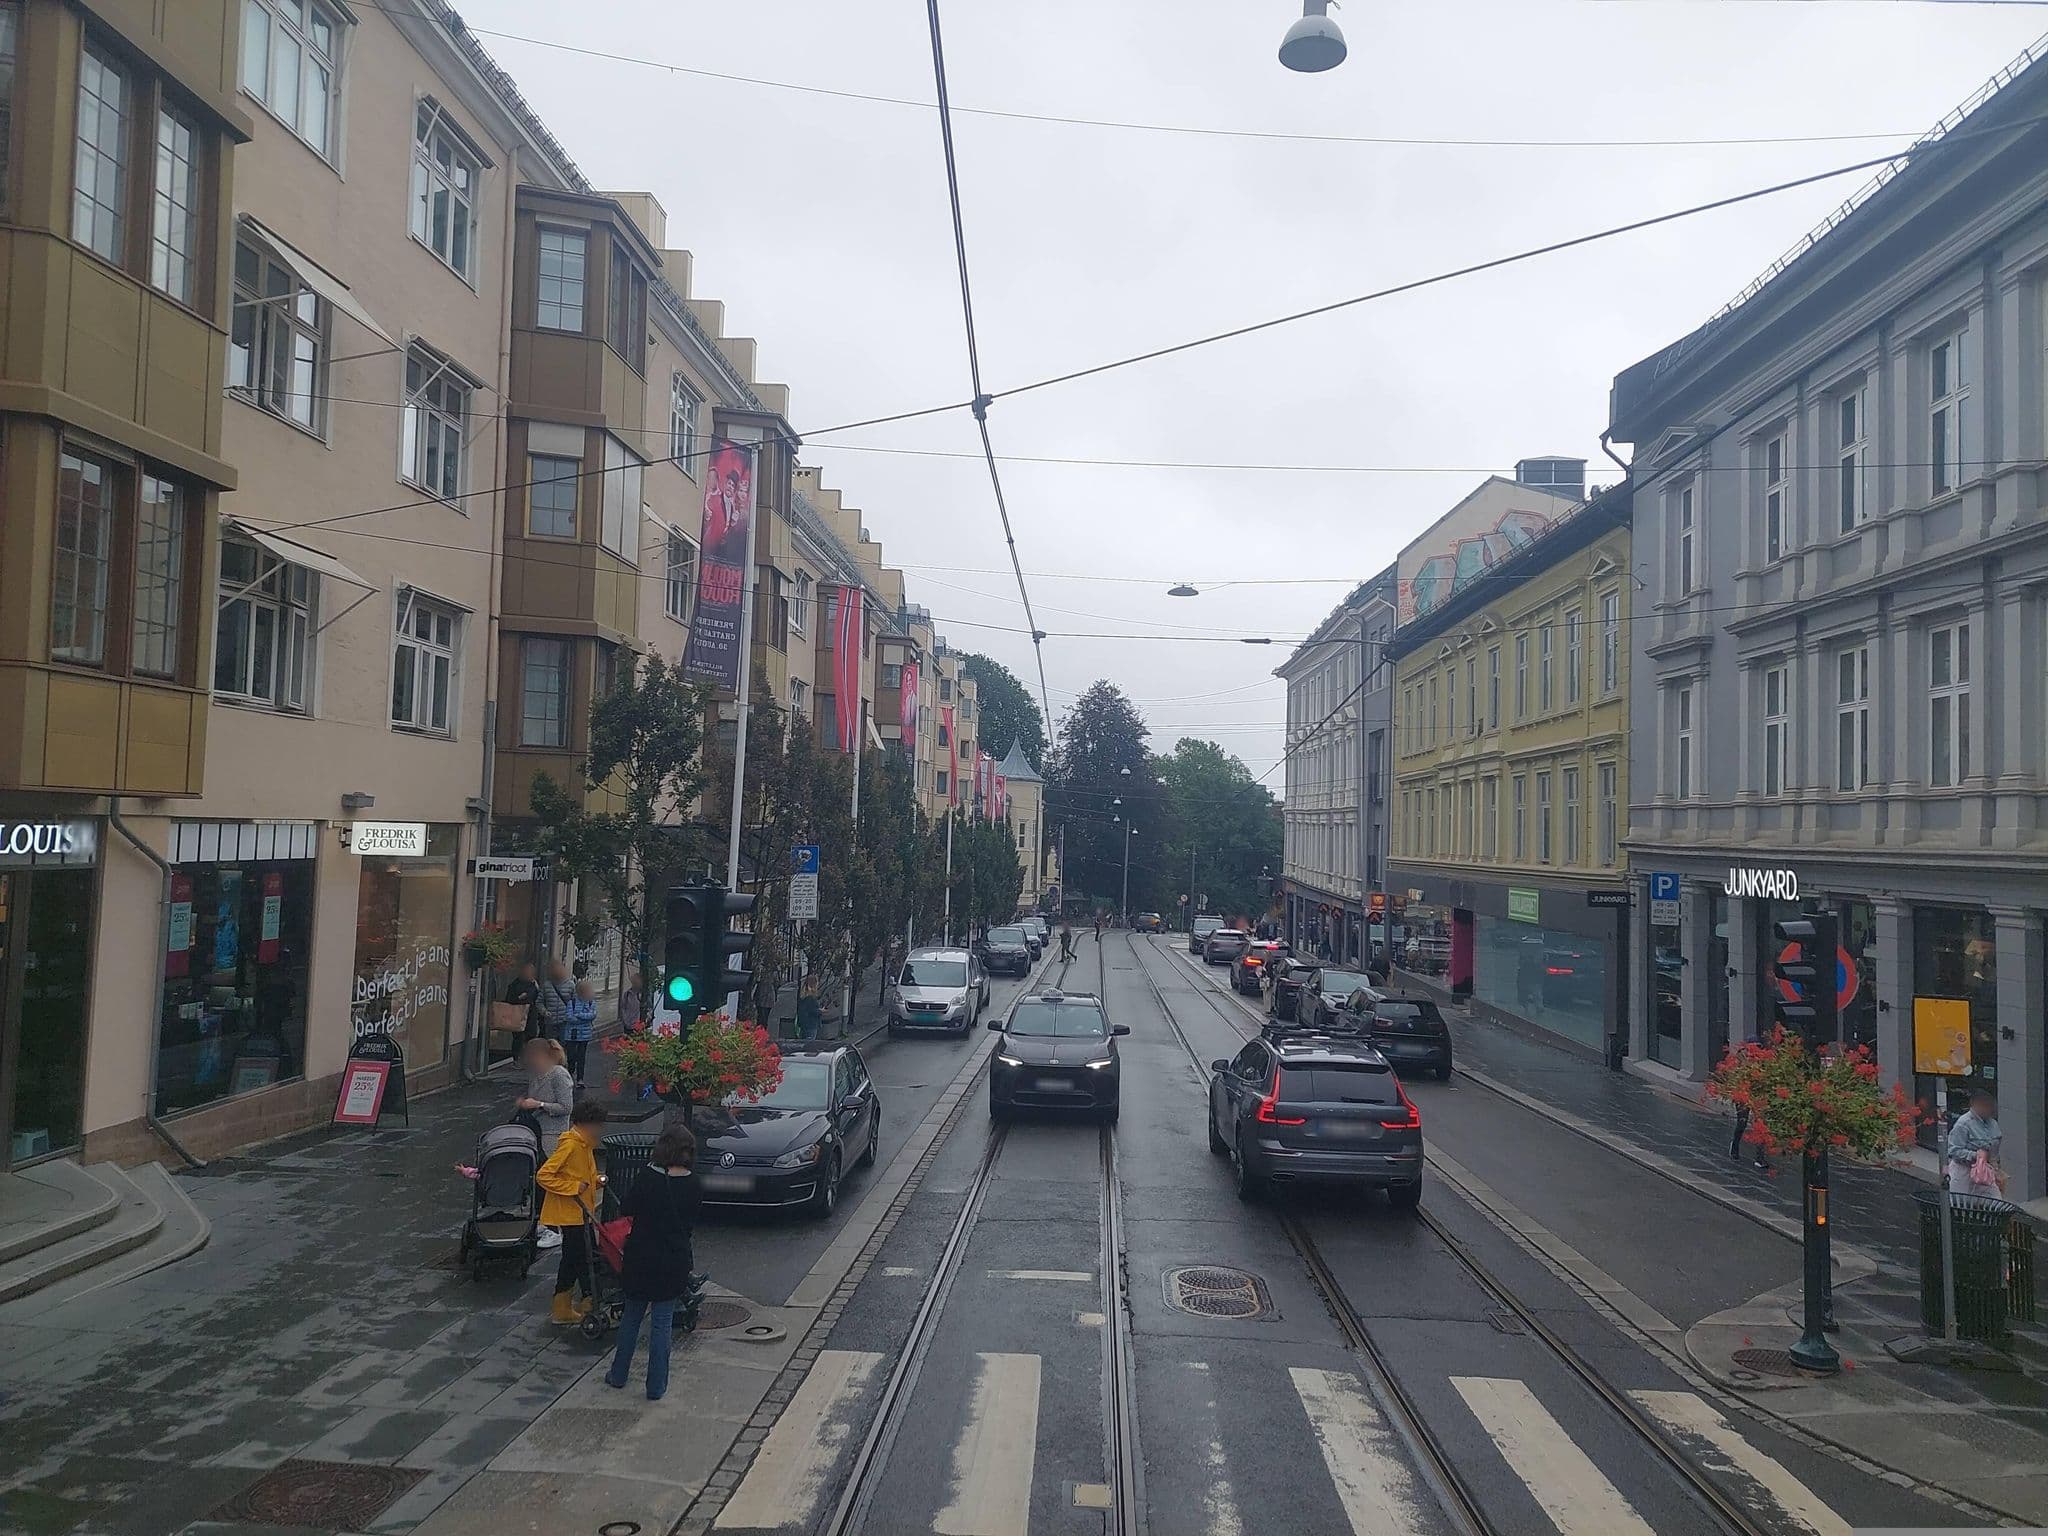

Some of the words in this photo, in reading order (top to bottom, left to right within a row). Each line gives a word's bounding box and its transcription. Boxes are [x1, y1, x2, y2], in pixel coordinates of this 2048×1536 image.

[0, 823, 88, 855] LOUIS
[365, 828, 417, 839] FREDRIK
[1658, 876, 1673, 897] P
[357, 958, 411, 1000] perfect
[355, 998, 410, 1042] perfect
[412, 985, 448, 1018] jeans
[353, 1081, 375, 1092] 25%
